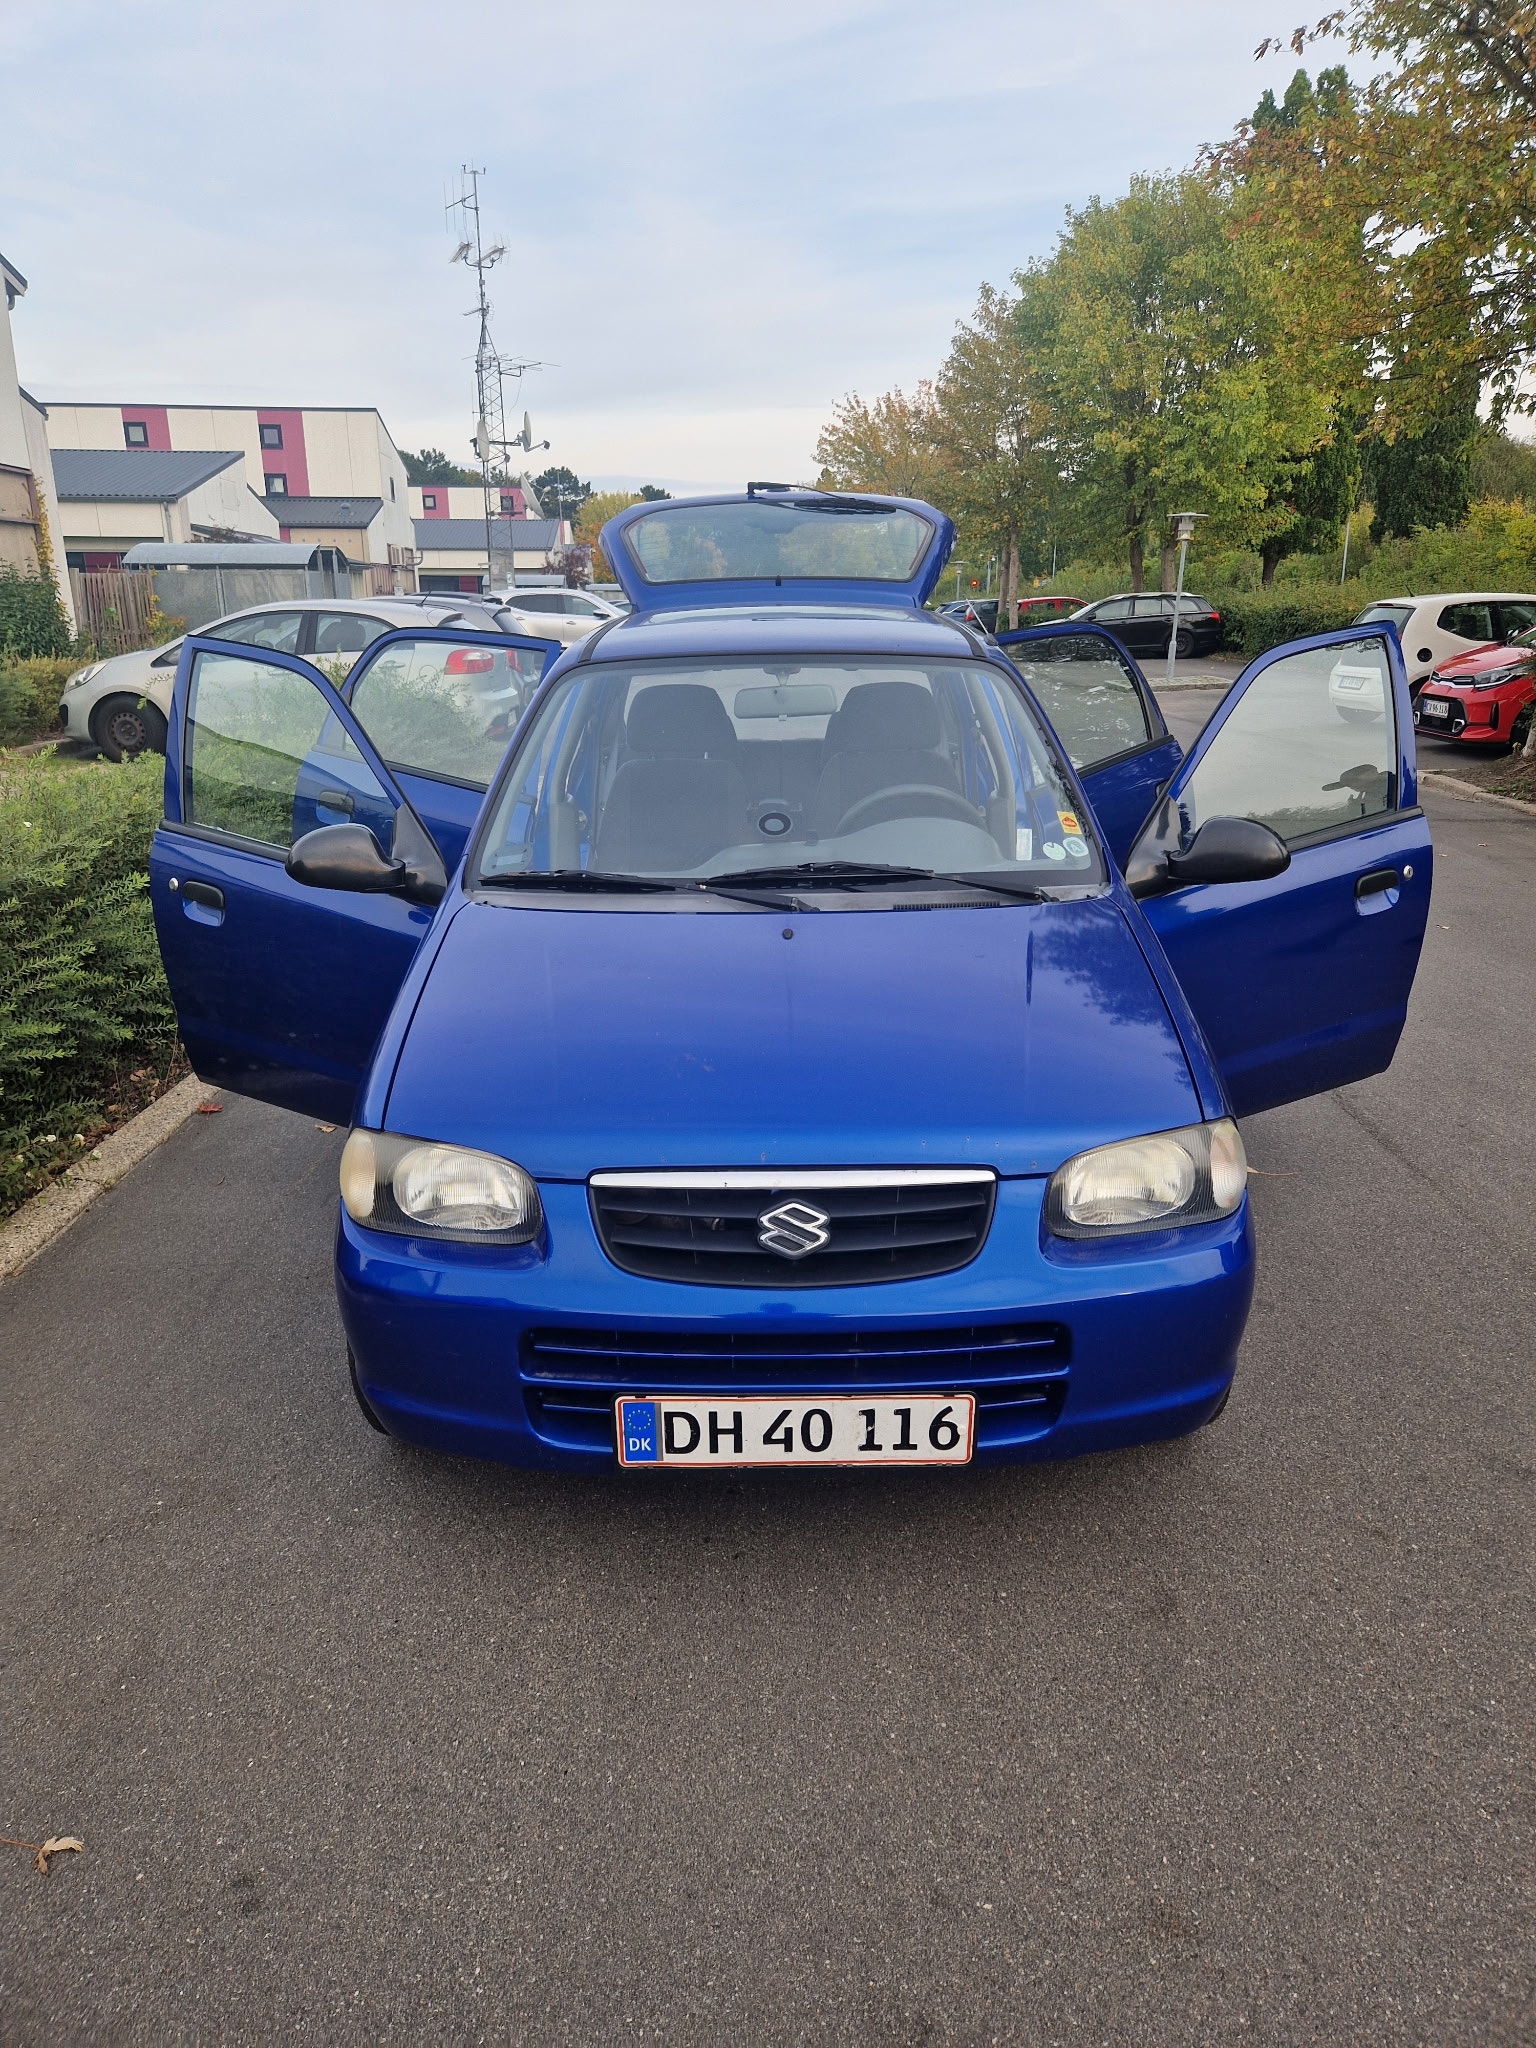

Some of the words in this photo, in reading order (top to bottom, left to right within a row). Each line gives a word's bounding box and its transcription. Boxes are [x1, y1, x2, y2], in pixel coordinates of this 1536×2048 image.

[629, 1437, 652, 1452] DK
[664, 1411, 743, 1454] DH
[763, 1408, 833, 1453] 40
[858, 1405, 962, 1451] 116
